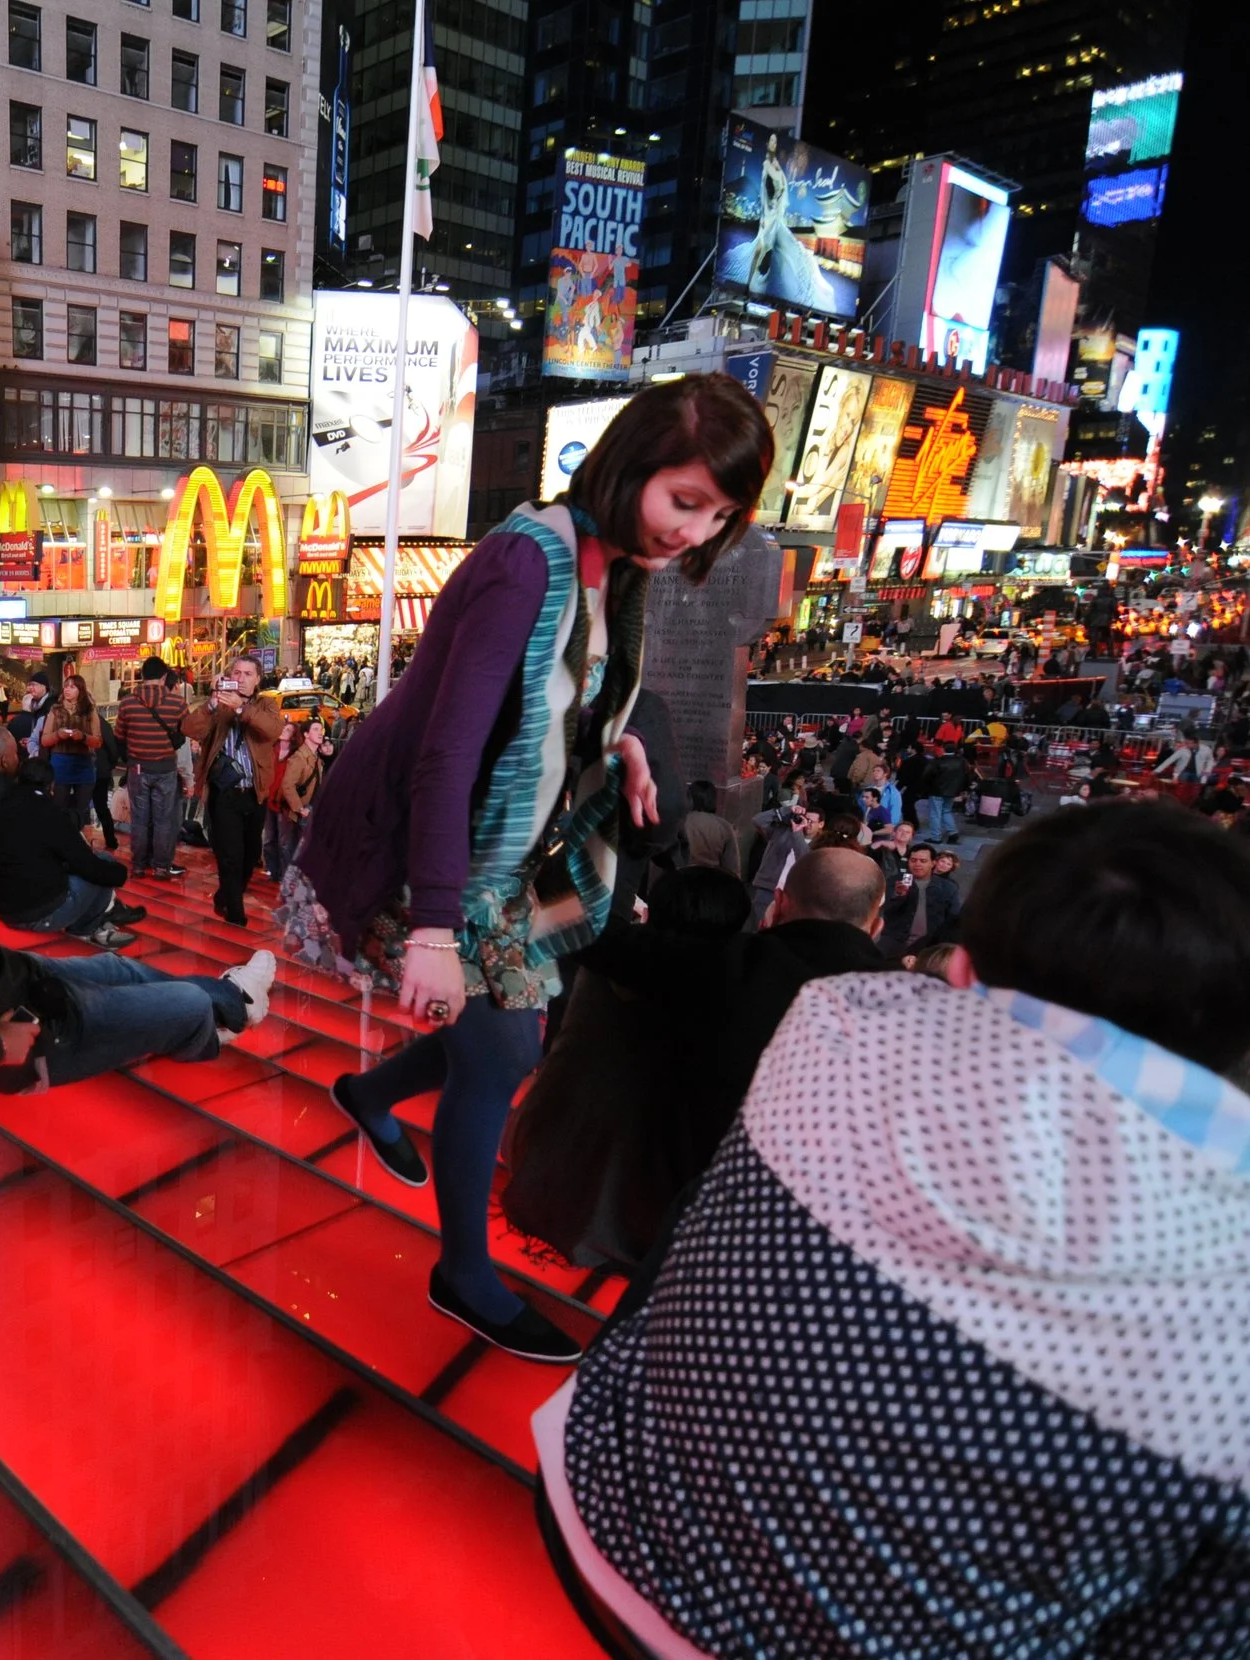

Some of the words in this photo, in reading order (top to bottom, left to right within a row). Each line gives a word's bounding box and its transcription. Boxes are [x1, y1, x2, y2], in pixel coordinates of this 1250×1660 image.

[620, 158, 646, 172] AWARDS
[565, 161, 584, 176] BEST
[585, 164, 616, 182] MUSICAL
[617, 169, 645, 186] REVIVAL
[562, 180, 643, 224] SOUTH
[559, 213, 639, 257] PACIFIC
[326, 324, 380, 337] WHERE
[324, 336, 439, 355] MAXIMUM
[324, 353, 438, 368] PERFORMNCE
[322, 366, 388, 383] LIVES
[327, 430, 347, 441] DVD
[301, 541, 346, 552] McDonald's
[349, 568, 366, 577] DAYS
[395, 568, 418, 577] RIDAYS
[707, 576, 748, 586] DUFFY
[98, 621, 117, 630] TIMES
[118, 620, 141, 629] SQUARE
[100, 628, 139, 637] INFORMATION
[109, 636, 131, 644] CENTER
